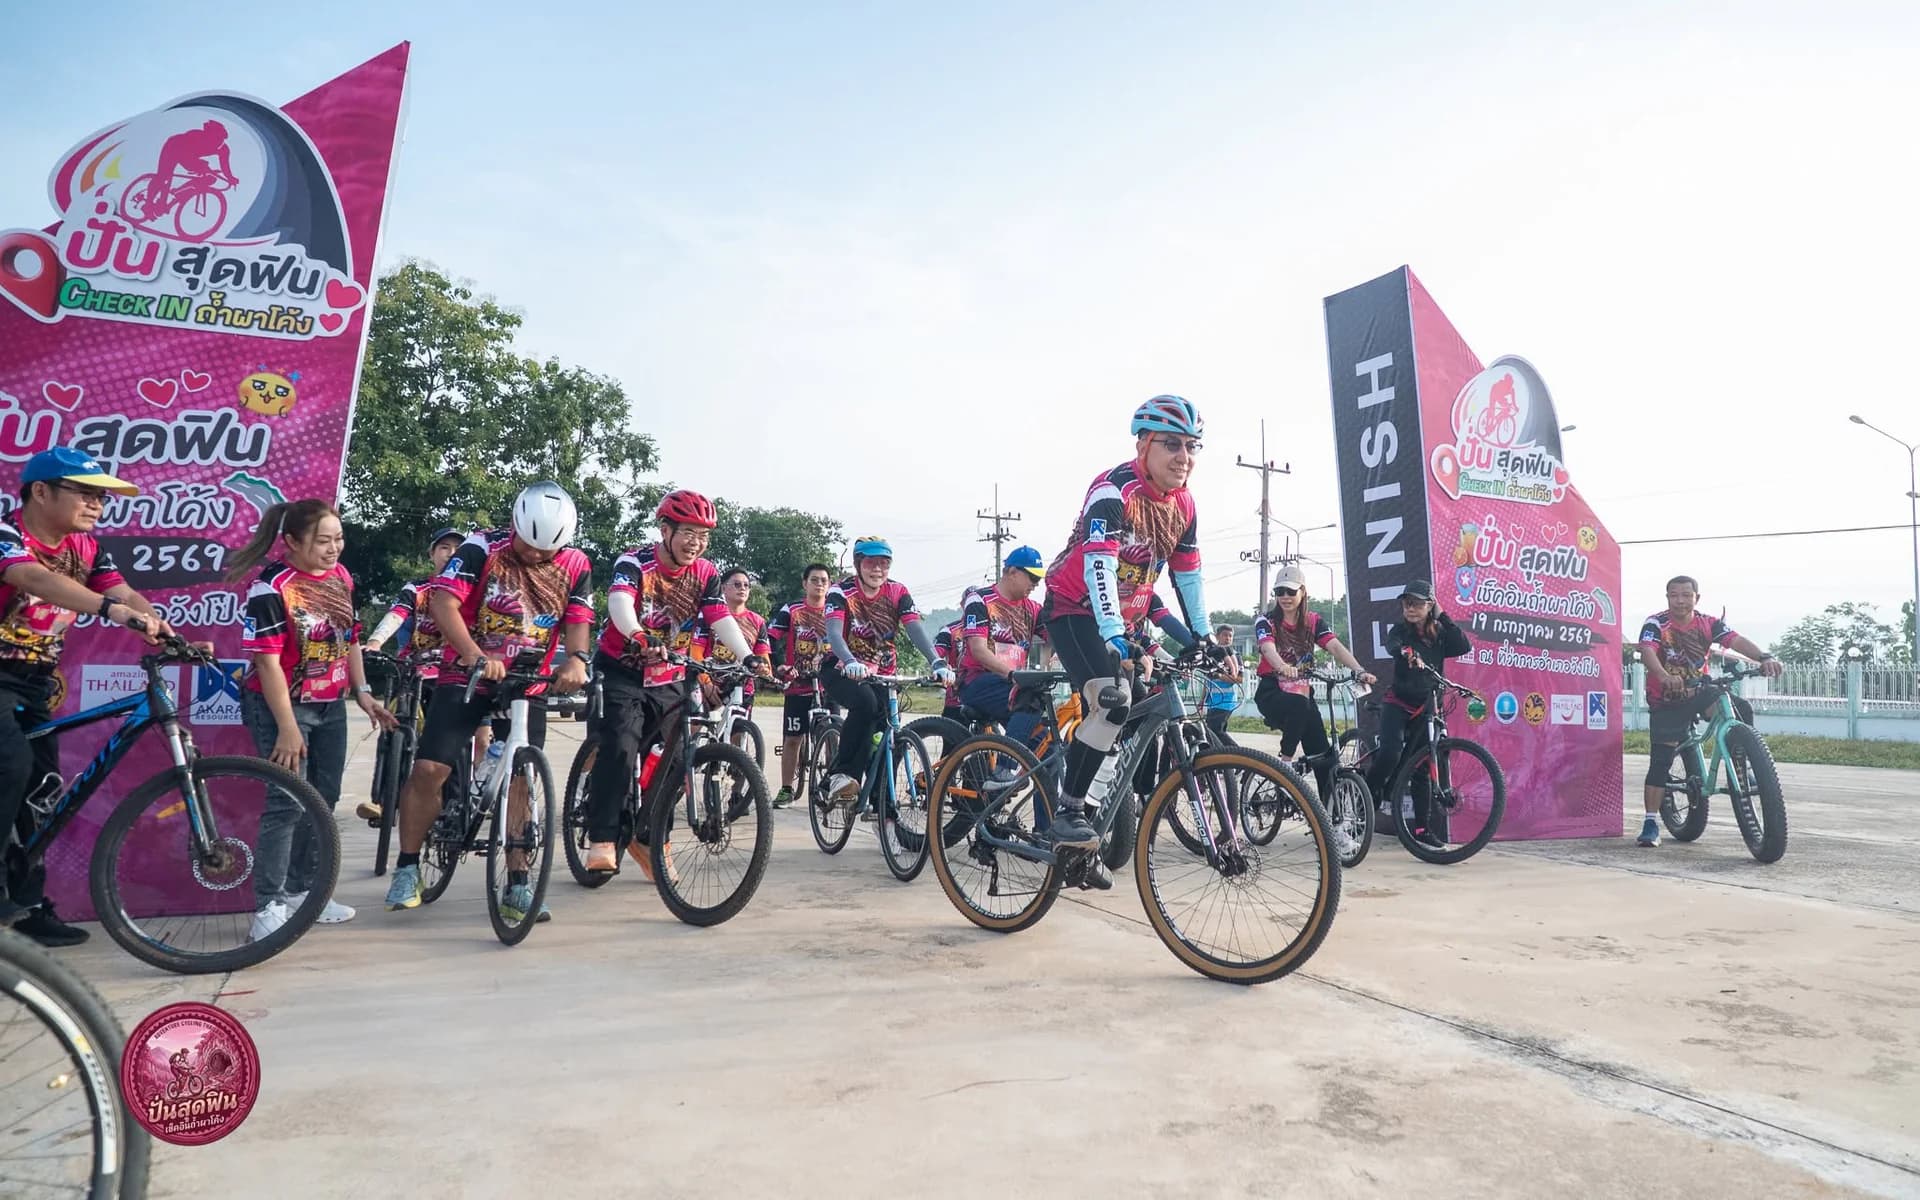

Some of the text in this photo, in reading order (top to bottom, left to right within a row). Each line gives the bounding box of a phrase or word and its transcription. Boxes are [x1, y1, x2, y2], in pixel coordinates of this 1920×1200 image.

[66, 200, 321, 295] ปั่น สุดฟิน
[60, 278, 313, 335] CHECK IN ถ้ำผาโค้ง
[1497, 449, 1553, 478] สุดฟิน
[1460, 472, 1493, 494] CHECK
[1493, 480, 1506, 497] IN
[133, 544, 225, 572] 2569
[1475, 515, 1587, 582] ปั่น สุดฟิน
[1131, 595, 1148, 608] 001
[1476, 580, 1594, 619] เช็คอินถ้ำผาโค้ง
[1472, 613, 1592, 645] 19 กรกฎาคม 2569
[1479, 650, 1493, 663] ณ
[86, 679, 176, 692] THAILAD
[110, 671, 149, 679] amazin
[787, 716, 801, 732] 15
